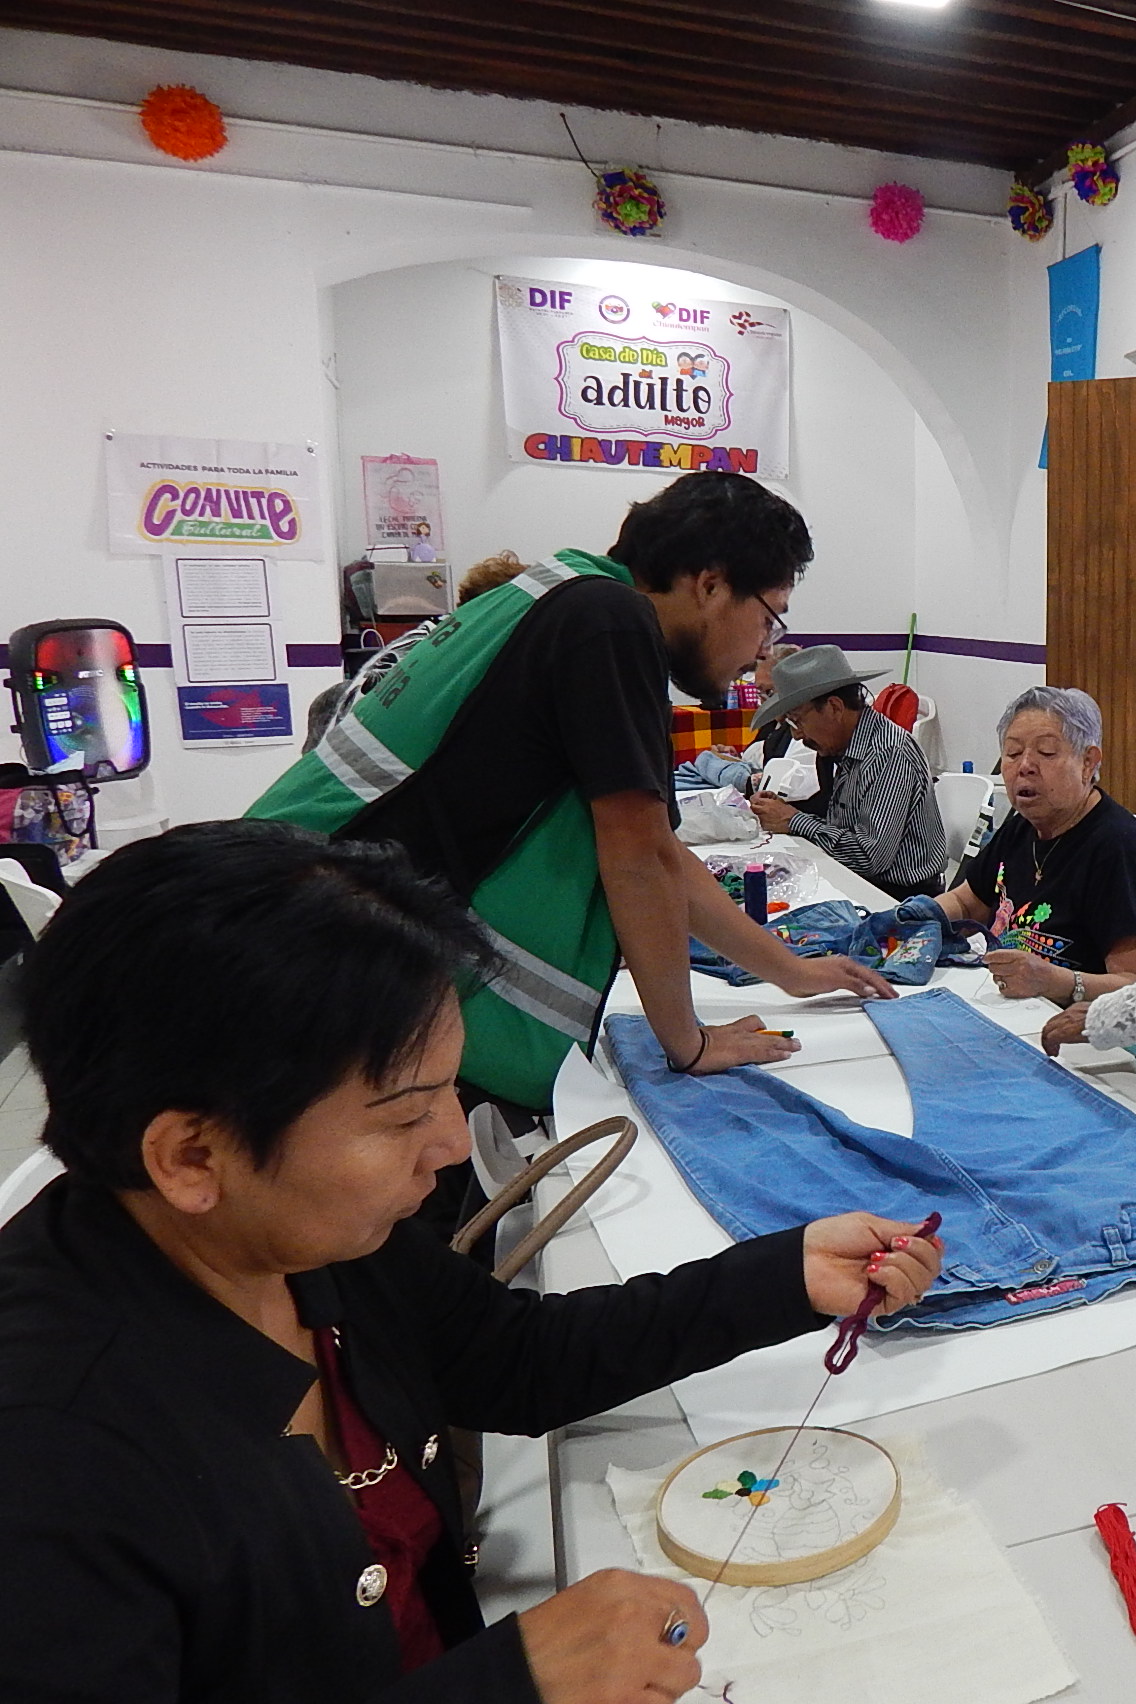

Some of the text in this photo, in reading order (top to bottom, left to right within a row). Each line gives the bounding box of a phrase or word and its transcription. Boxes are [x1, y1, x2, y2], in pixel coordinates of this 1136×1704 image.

[528, 286, 573, 311] DIF
[678, 307, 711, 325] DIF
[580, 342, 617, 362] Casa
[618, 346, 639, 364] de
[580, 372, 712, 415] adulto
[523, 432, 759, 474] CHIAUTEMPAN
[139, 462, 299, 477] ACTIVIDADES PARA TODA LA FAMILIA
